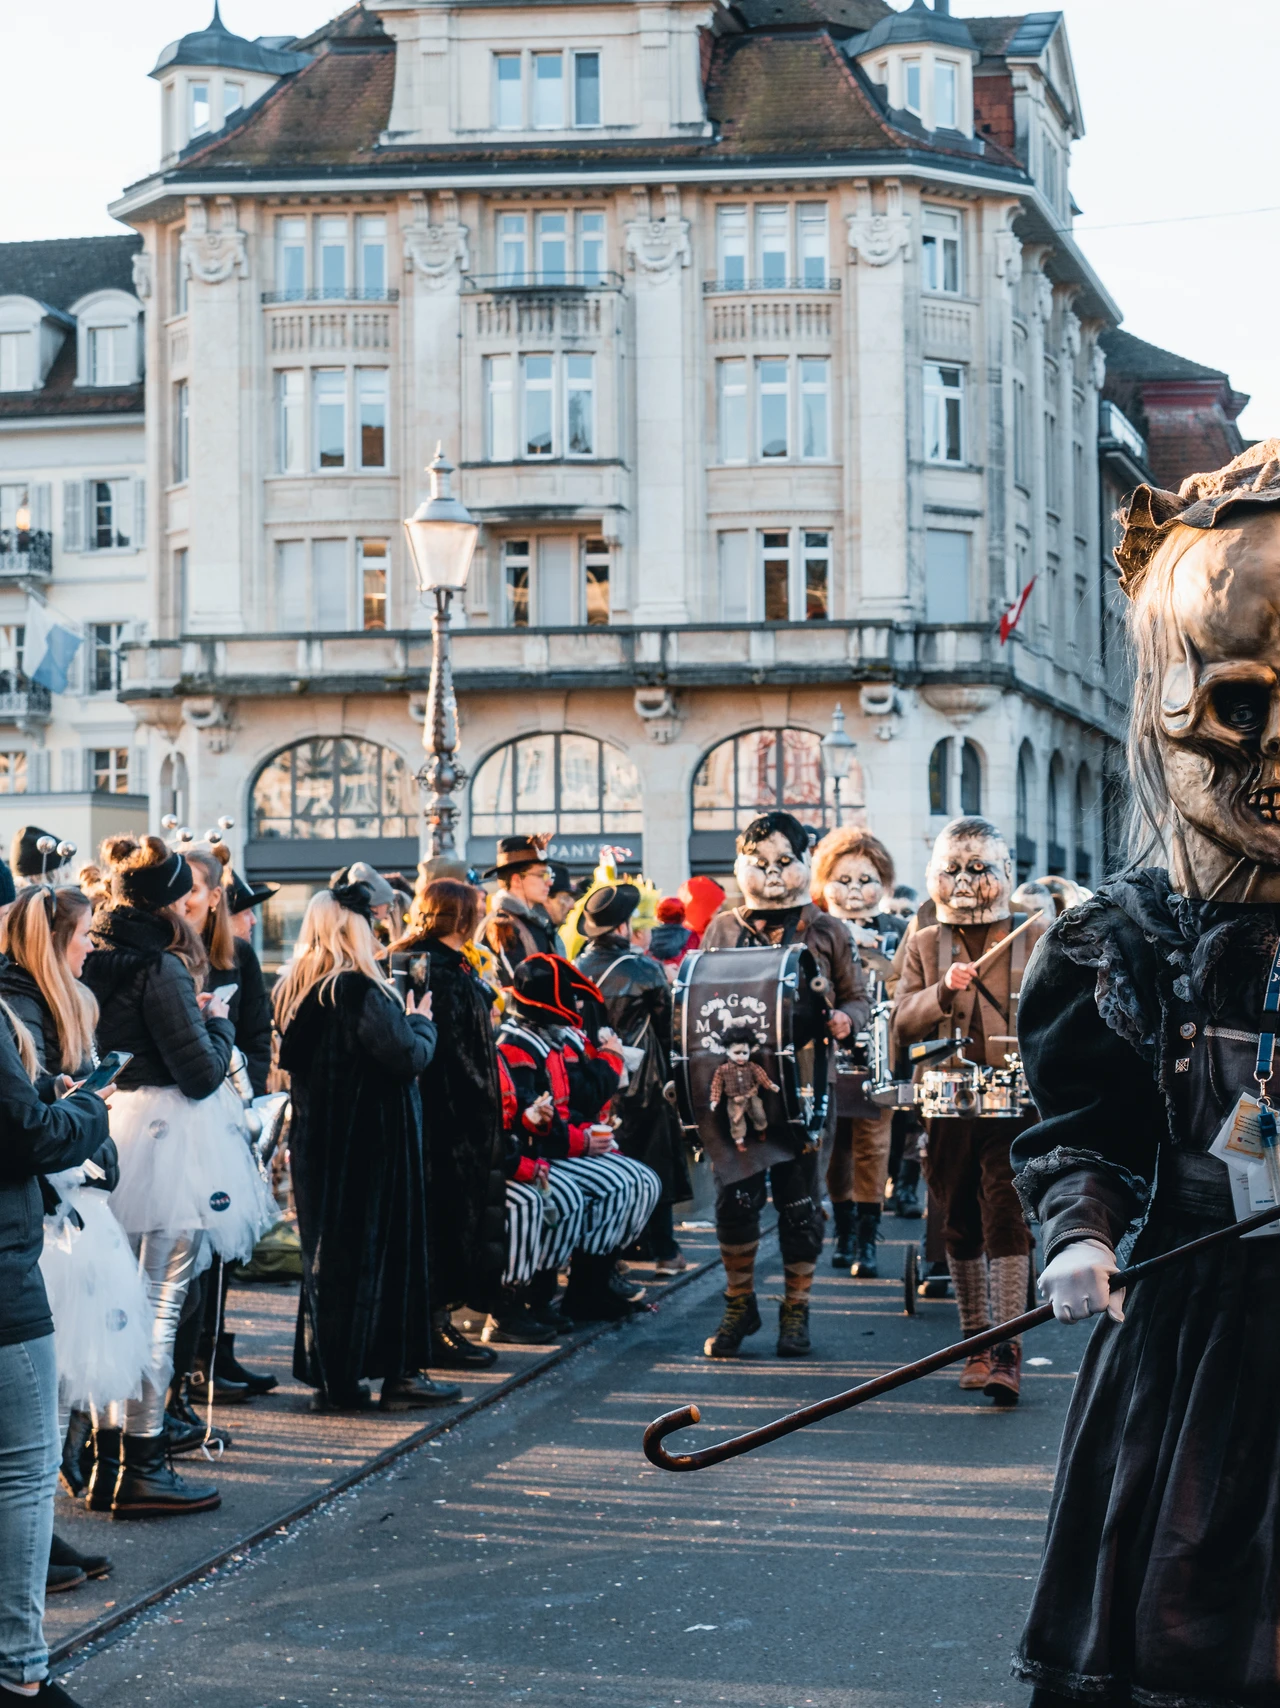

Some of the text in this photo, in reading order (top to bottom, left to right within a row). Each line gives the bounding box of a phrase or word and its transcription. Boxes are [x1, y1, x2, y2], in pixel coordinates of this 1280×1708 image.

[548, 843, 604, 858] PANY
[726, 993, 739, 1008] G
[695, 1016, 770, 1033] M L
